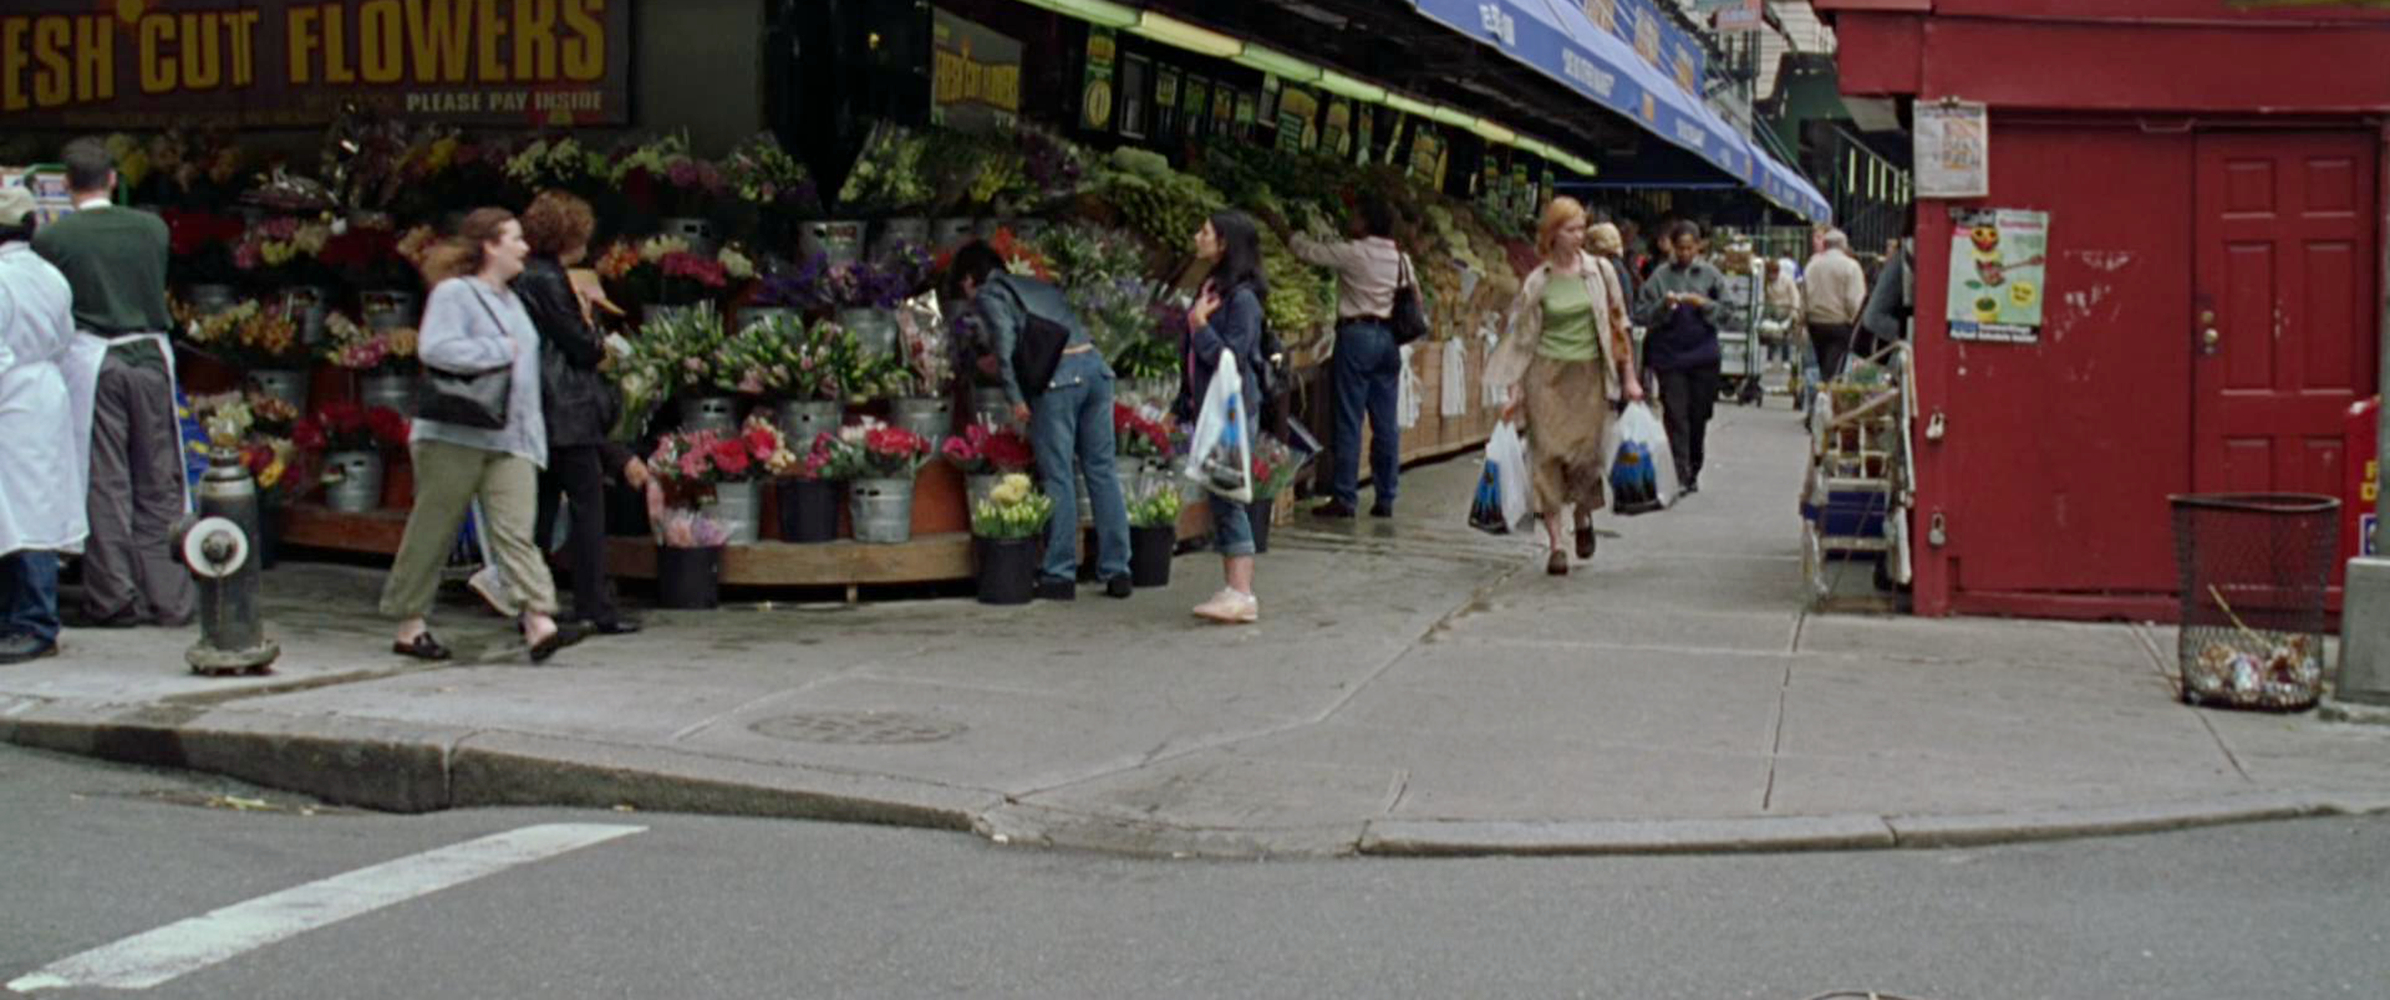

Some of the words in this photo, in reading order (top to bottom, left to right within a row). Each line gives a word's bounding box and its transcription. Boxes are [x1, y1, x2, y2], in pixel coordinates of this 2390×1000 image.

[2, 15, 116, 112] ESH
[139, 11, 258, 94] CUT
[288, 0, 606, 84] FLOWERS
[406, 91, 481, 112] PLEASE
[490, 91, 527, 112] PAY
[535, 90, 602, 111] INSIDE
